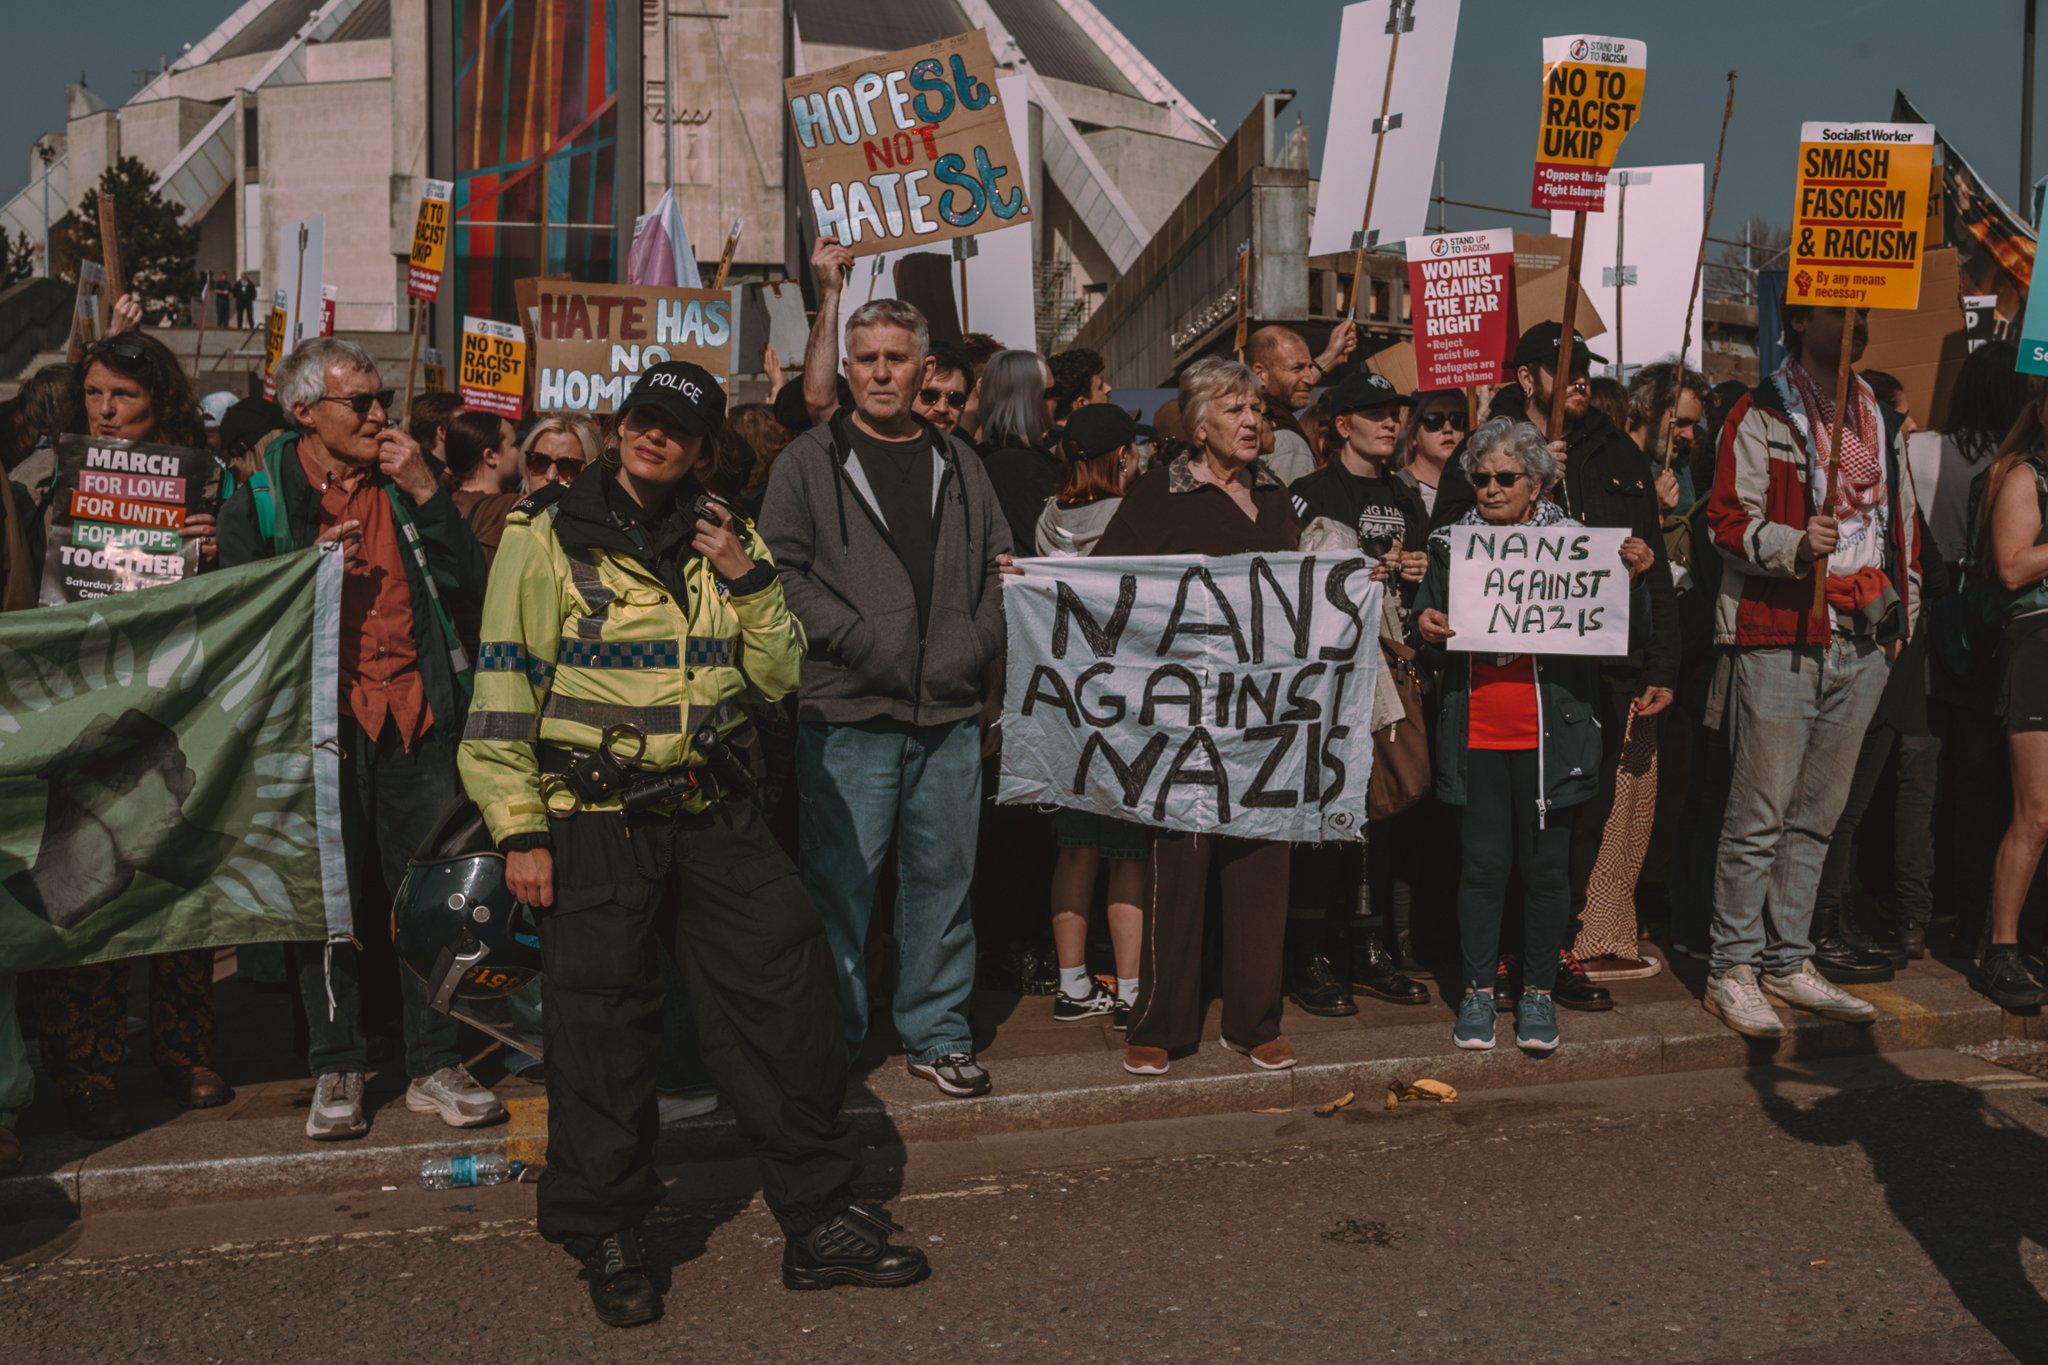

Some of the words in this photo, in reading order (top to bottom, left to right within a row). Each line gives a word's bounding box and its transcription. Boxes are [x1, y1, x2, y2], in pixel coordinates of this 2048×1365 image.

[1590, 41, 1613, 51] STAND
[1613, 43, 1625, 53] UP
[1590, 52, 1600, 61] TO
[1601, 53, 1628, 64] RACISM
[1549, 67, 1587, 97] NO
[1595, 70, 1626, 100] TO
[1546, 97, 1637, 132] RACIST
[862, 122, 939, 172] NOT
[1543, 127, 1603, 159] UKIP
[1546, 168, 1580, 182] Oppose
[1804, 147, 1890, 179] SMASH
[1544, 183, 1567, 197] Fight
[431, 203, 443, 224] TO
[1800, 187, 1906, 220] FASCISM
[416, 221, 445, 246] RACIST
[1450, 236, 1474, 246] STAND
[1475, 235, 1486, 244] UP
[1796, 227, 1816, 257] &
[1823, 228, 1918, 260] RACISM
[1451, 246, 1461, 254] TO
[1462, 243, 1490, 253] RACISM
[1421, 257, 1492, 280] WOMEN
[1816, 270, 1829, 285] By
[1832, 273, 1851, 286] any
[1853, 273, 1886, 286] means
[1423, 274, 1503, 299] AGAINST
[1815, 287, 1867, 302] necessary
[1424, 297, 1461, 317] THE
[1464, 294, 1499, 313] FAR
[540, 292, 647, 341] HATE
[656, 298, 730, 348] HAS
[1426, 314, 1482, 337] RIGHT
[466, 334, 488, 352] NO
[494, 339, 513, 357] TO
[1432, 338, 1463, 351] Reject
[1433, 349, 1462, 361] racist
[1463, 348, 1480, 358] lies
[464, 351, 521, 375] RACIST
[611, 344, 671, 372] NO
[1434, 362, 1478, 375] Refugees
[1480, 360, 1495, 368] are
[463, 367, 502, 387] UKIP
[649, 373, 703, 405] POLICE
[1435, 374, 1451, 385] not
[1453, 373, 1464, 382] to
[1465, 370, 1493, 382] blame
[86, 447, 180, 477] MARCH
[84, 475, 121, 494] FOR
[127, 478, 180, 499] LOVE.
[76, 495, 114, 517] FOR
[120, 502, 180, 528] UNITY.
[77, 525, 115, 543] FOR
[121, 527, 176, 548] HOPE.
[1465, 532, 1591, 562] NANS
[60, 546, 185, 576] TOGETHER
[65, 576, 113, 592] Saturday
[1484, 567, 1611, 604] AGAINST
[1051, 555, 1366, 664] NANS
[1487, 602, 1605, 637] NAZIS
[1021, 662, 1355, 729] AGAINST
[1073, 721, 1350, 824] NAZIS
